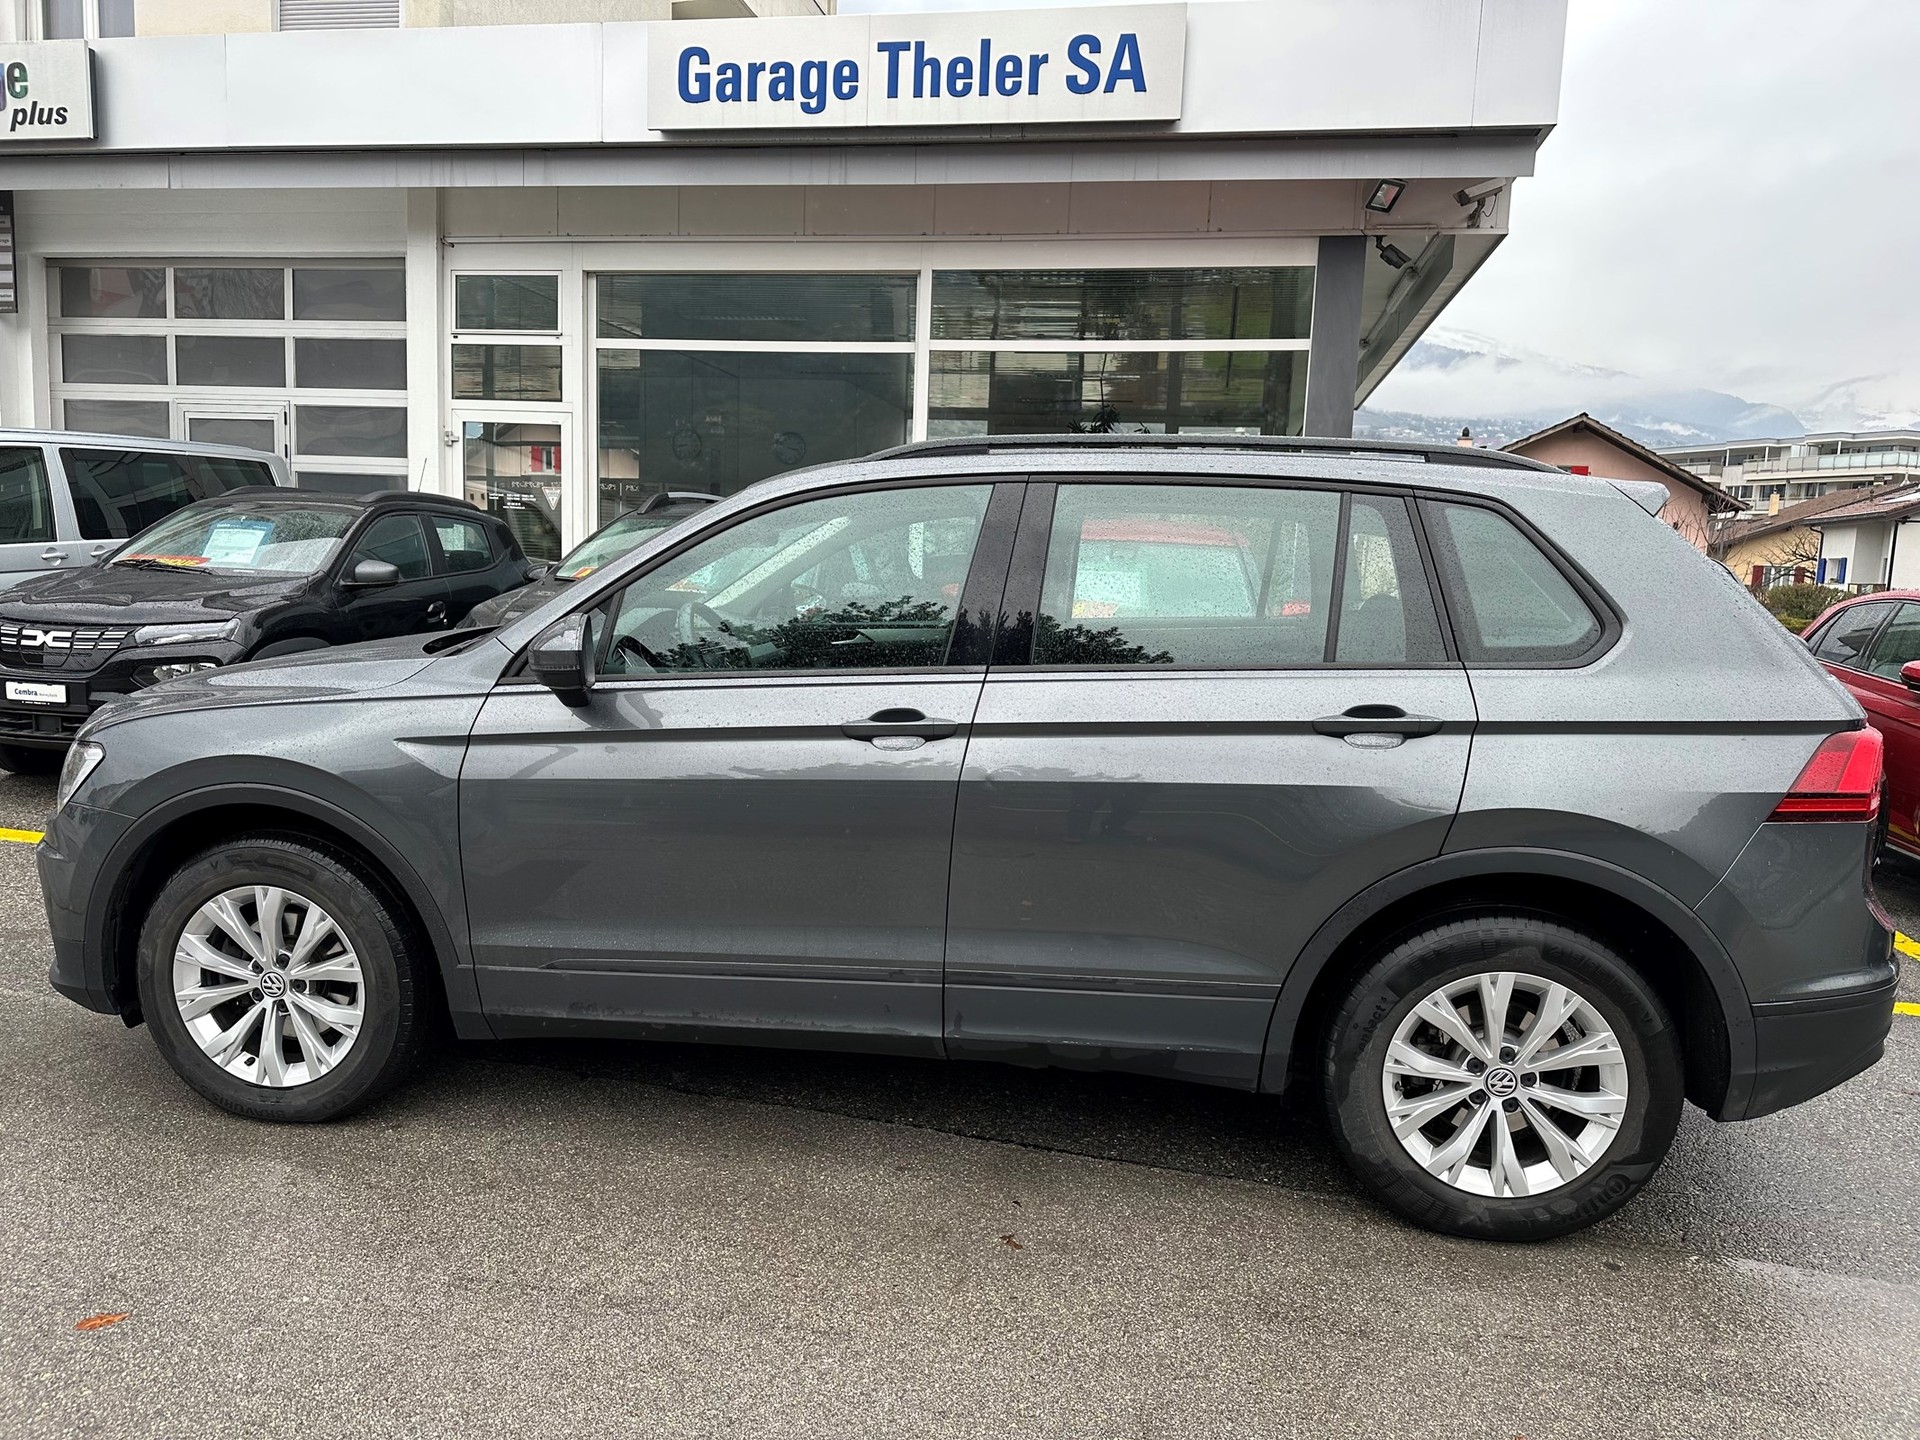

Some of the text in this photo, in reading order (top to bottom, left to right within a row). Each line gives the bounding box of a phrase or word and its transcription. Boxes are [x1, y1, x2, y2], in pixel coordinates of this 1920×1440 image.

[677, 33, 1147, 115] Garage Theler SA
[10, 101, 68, 132] plus
[14, 688, 38, 696] Cembra
